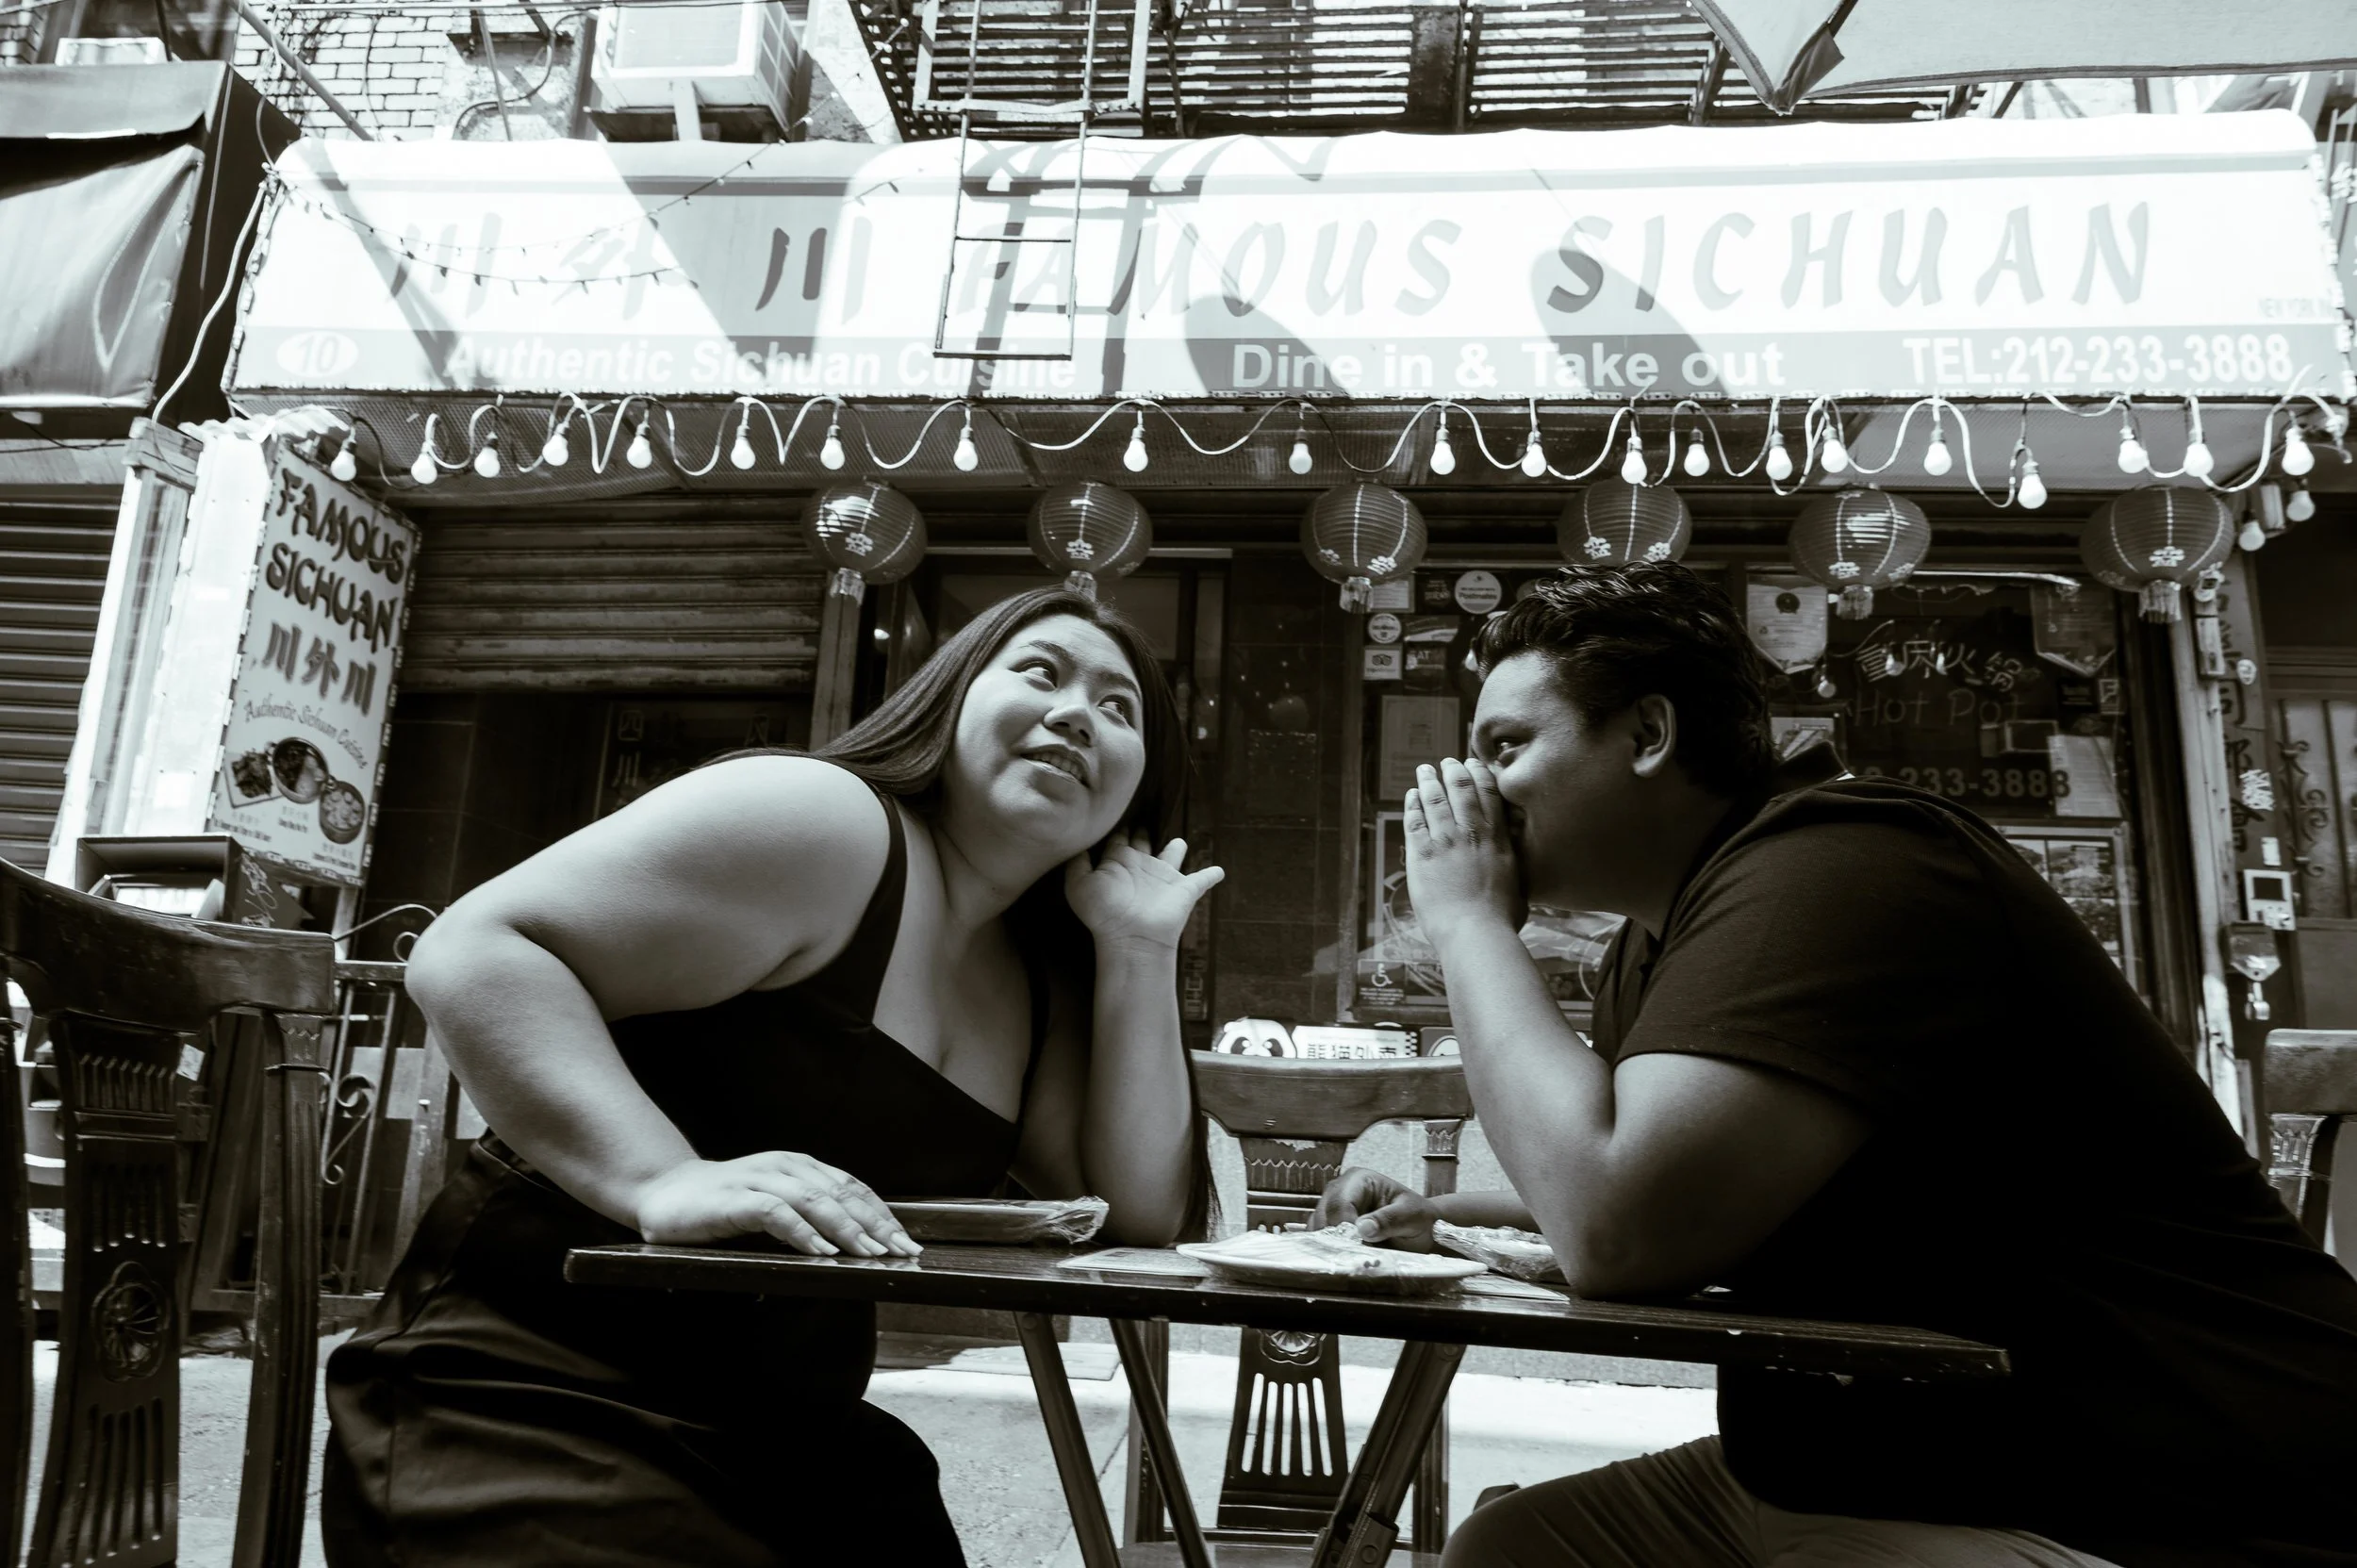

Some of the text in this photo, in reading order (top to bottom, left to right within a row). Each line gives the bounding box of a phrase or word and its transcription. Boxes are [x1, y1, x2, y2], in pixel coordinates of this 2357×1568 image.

[956, 201, 2150, 318] FAMOUS SICHUAN
[295, 334, 339, 376] 10
[447, 338, 1077, 388] Authentic Sichuan Cuisine
[1232, 341, 1786, 388] Dine in & Take out
[1904, 334, 2293, 385] TEL:212-233-3888
[276, 467, 406, 584] FAMOUS
[266, 542, 399, 653] SICHUAN
[261, 620, 376, 717] 川外川
[243, 692, 297, 723] Authentic
[1854, 689, 1930, 727] Hot
[1948, 687, 2025, 727] Pot
